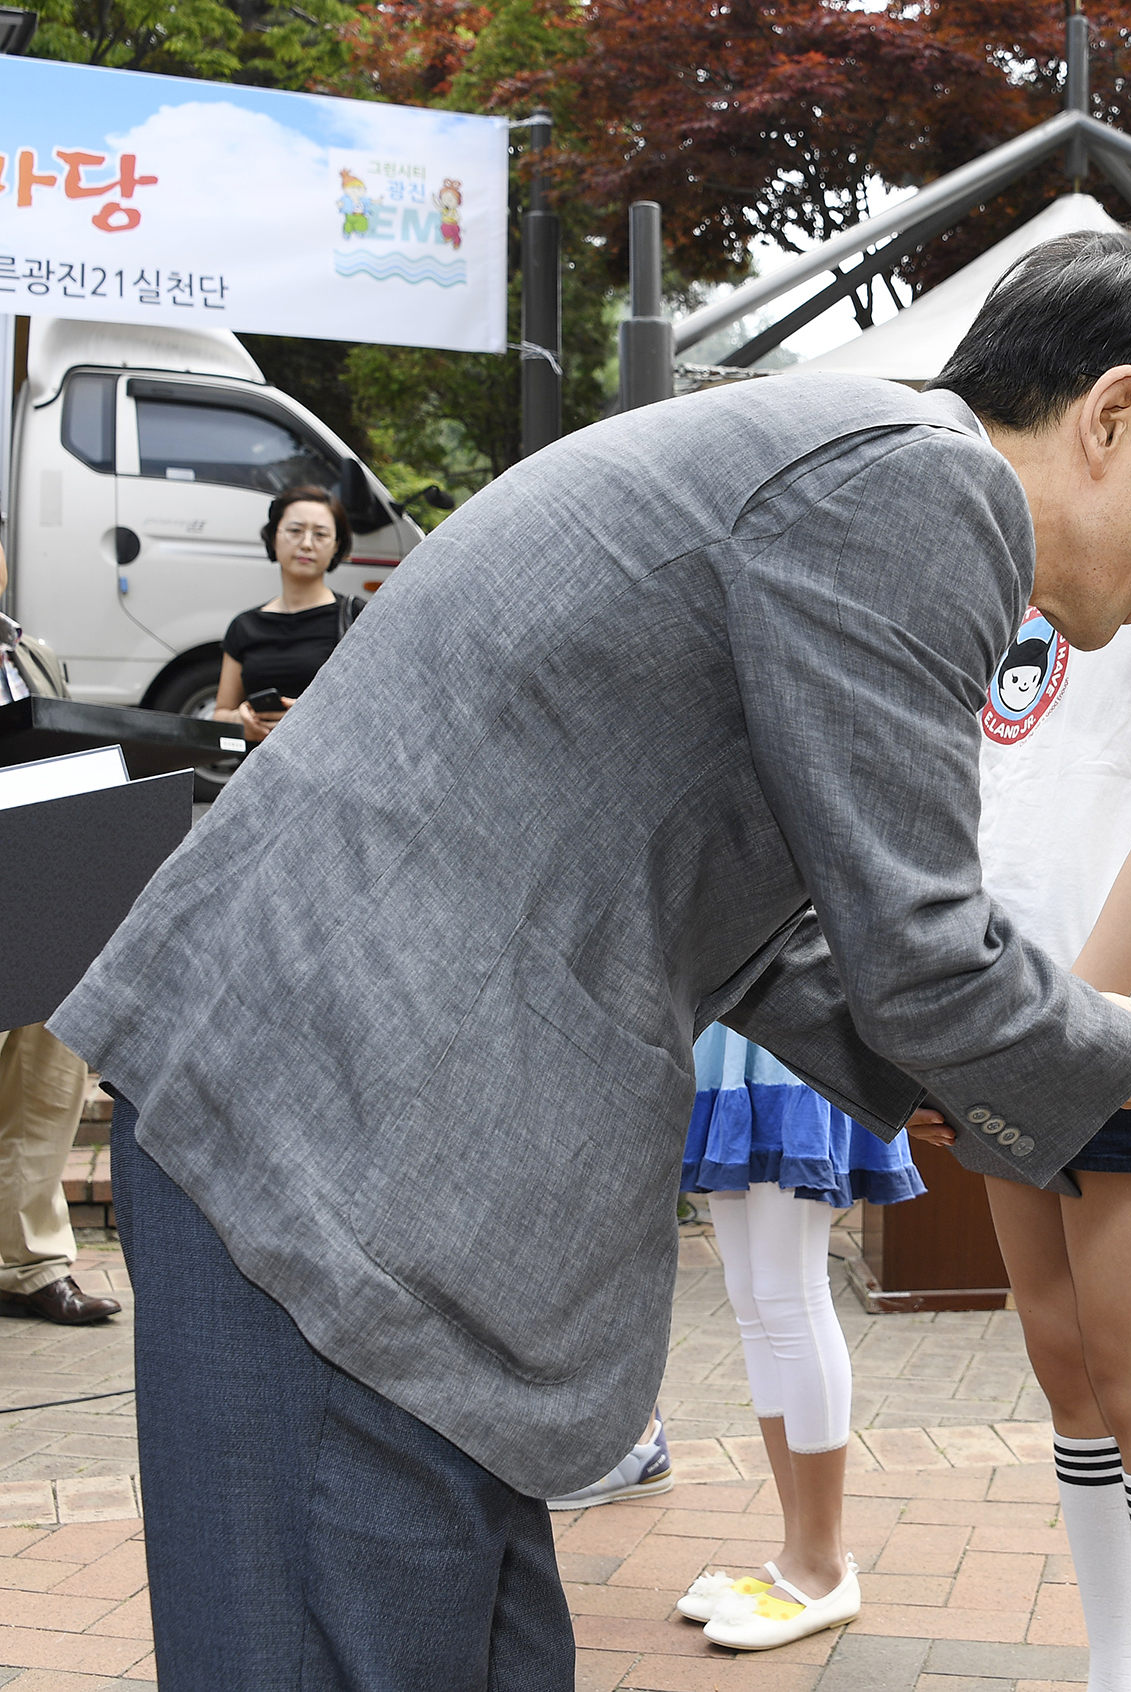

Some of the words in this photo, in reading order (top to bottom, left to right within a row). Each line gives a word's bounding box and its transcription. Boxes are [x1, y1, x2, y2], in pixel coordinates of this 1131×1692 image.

[367, 159, 426, 180] 그린시티
[386, 179, 425, 204] 광진
[366, 204, 446, 245] EM
[1046, 646, 1067, 698] HAVE
[984, 711, 1020, 739] E.LAND
[1020, 714, 1036, 734] JR.
